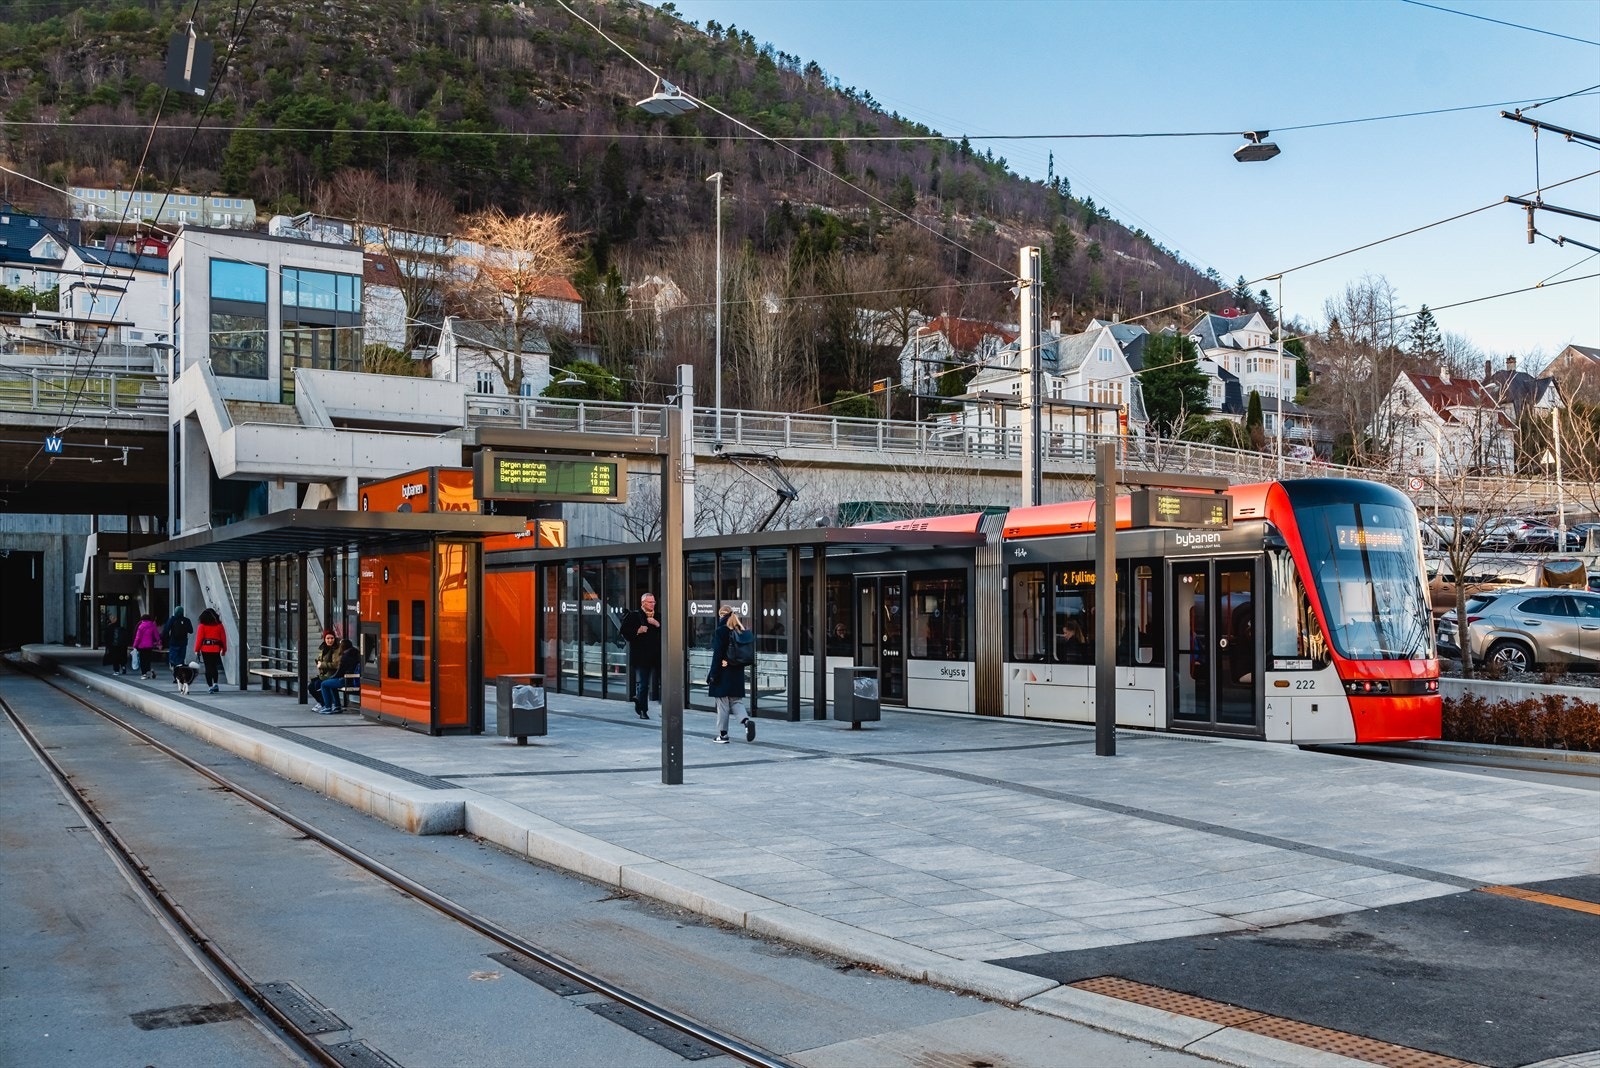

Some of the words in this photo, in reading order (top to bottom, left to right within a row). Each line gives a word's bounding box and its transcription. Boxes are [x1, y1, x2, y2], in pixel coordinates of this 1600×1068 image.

[46, 438, 62, 451] W
[500, 461, 521, 469] Bergen
[500, 468, 521, 476] Bergen
[500, 475, 521, 483] Bergen
[402, 484, 424, 500] bybanen
[1175, 532, 1221, 547] bybanen
[1340, 530, 1346, 544] 2
[1063, 573, 1068, 585] 2
[940, 666, 960, 678] skyss
[1295, 680, 1316, 690] 222
